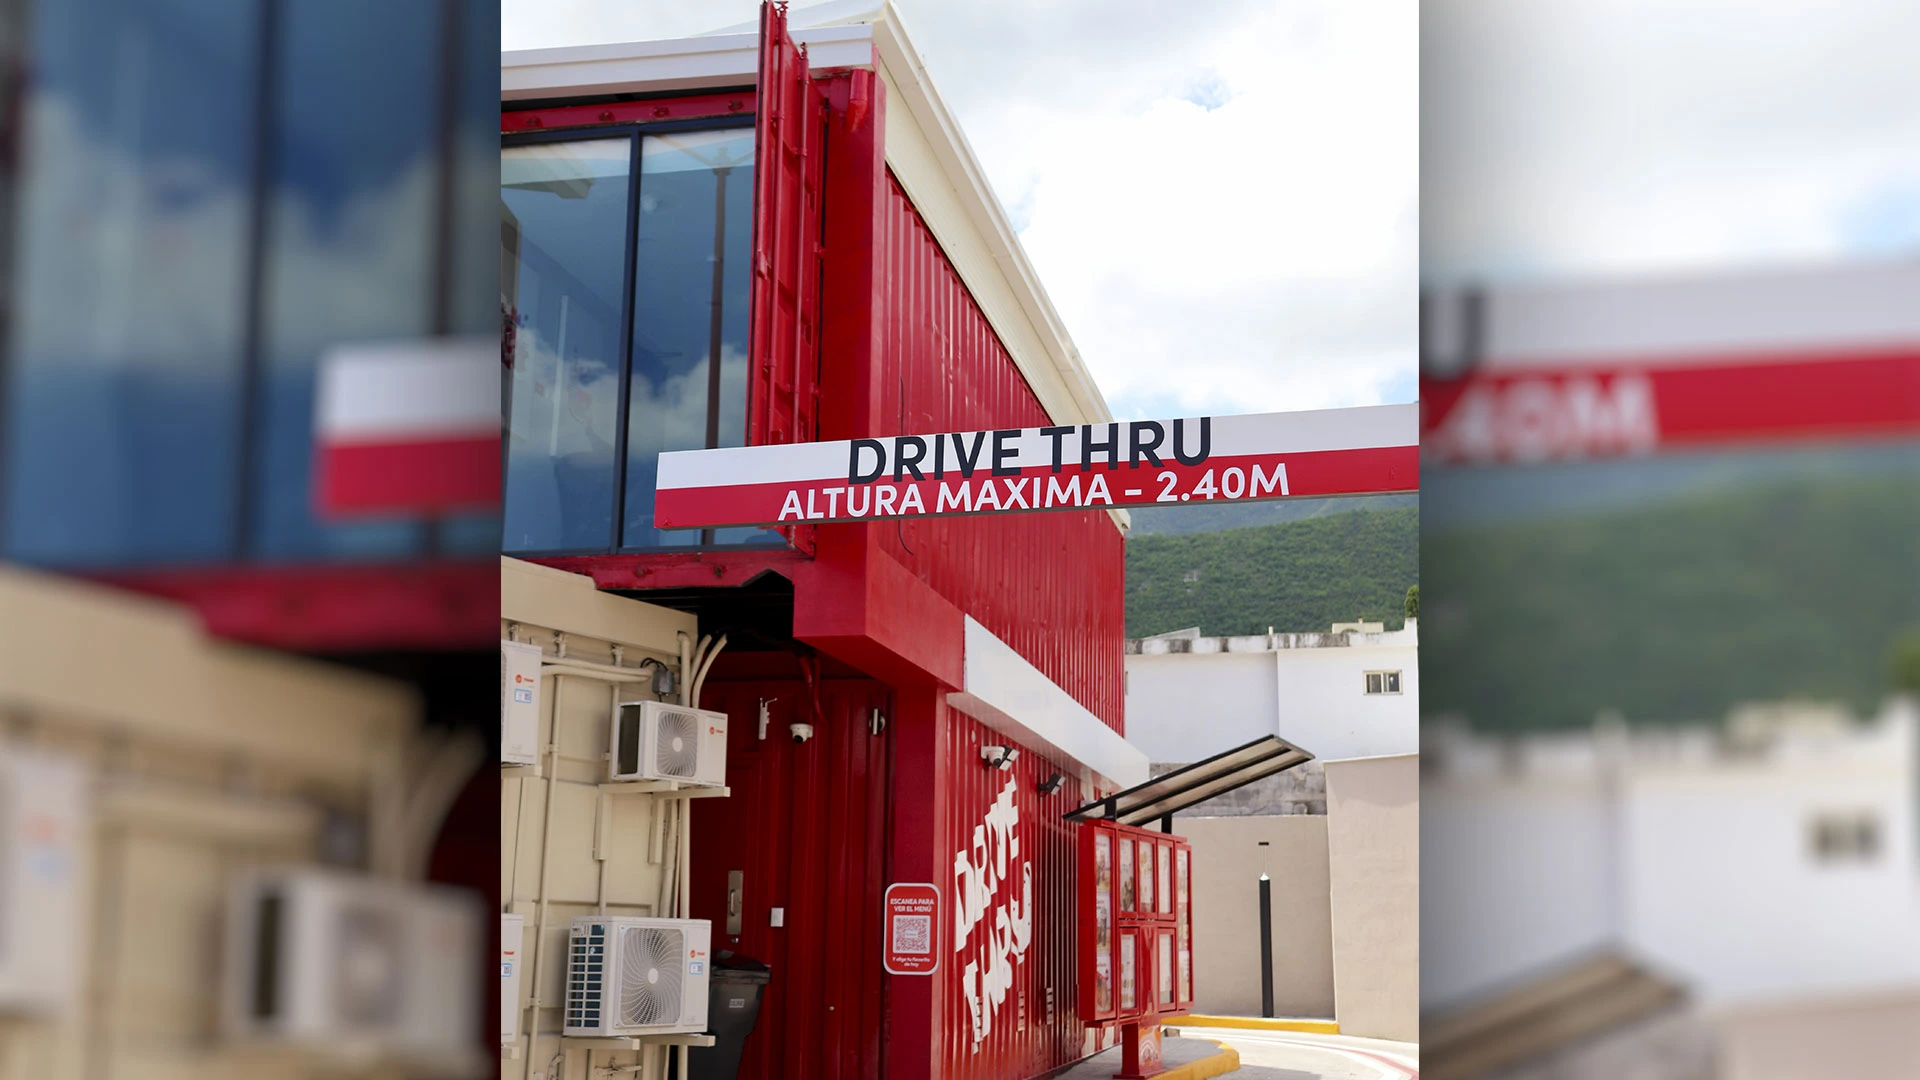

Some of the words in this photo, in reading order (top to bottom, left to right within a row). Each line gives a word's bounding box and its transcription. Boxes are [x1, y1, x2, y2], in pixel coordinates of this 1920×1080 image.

[848, 429, 1022, 485] DRIVE
[1040, 416, 1211, 473] THRU
[778, 483, 926, 521] ALTURA
[935, 473, 1113, 514] MAXIMA
[1156, 462, 1290, 502] 2.40M
[954, 773, 1020, 953] DRIVE
[914, 904, 931, 912] MENÚ
[963, 861, 1032, 1055] THRU
